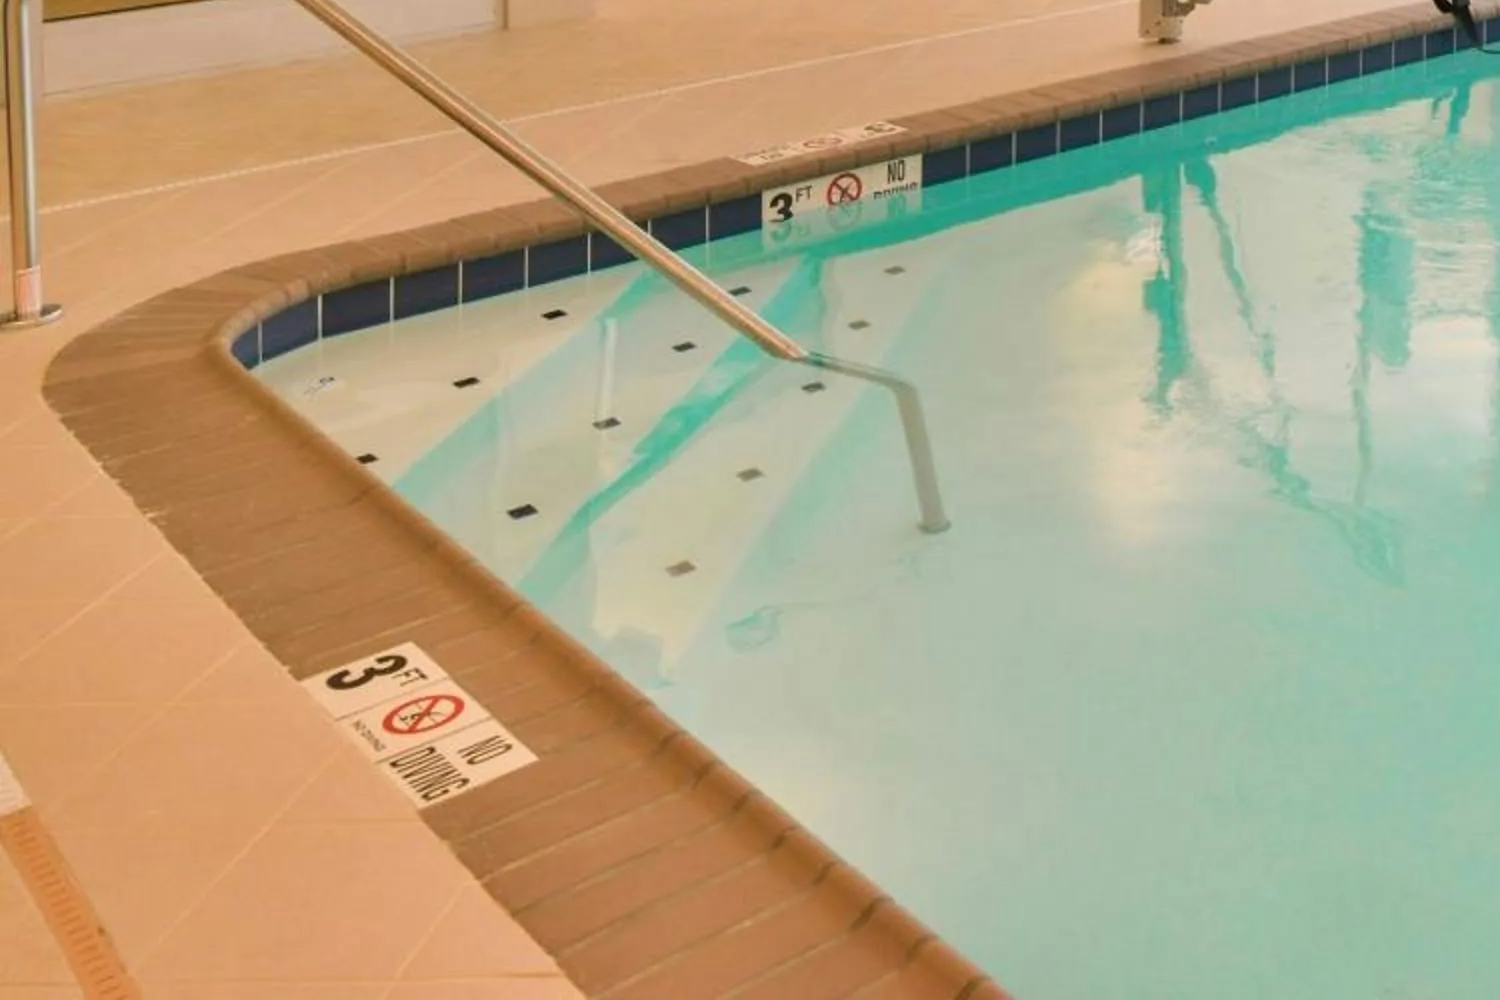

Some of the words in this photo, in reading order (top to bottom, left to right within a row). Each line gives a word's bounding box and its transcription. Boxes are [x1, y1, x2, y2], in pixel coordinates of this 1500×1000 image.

[887, 159, 905, 185] NO
[769, 192, 794, 223] 3
[796, 185, 813, 202] FT
[326, 655, 407, 690] 3
[392, 668, 428, 687] FT
[458, 735, 513, 766] NO
[389, 746, 470, 802] DIVING
